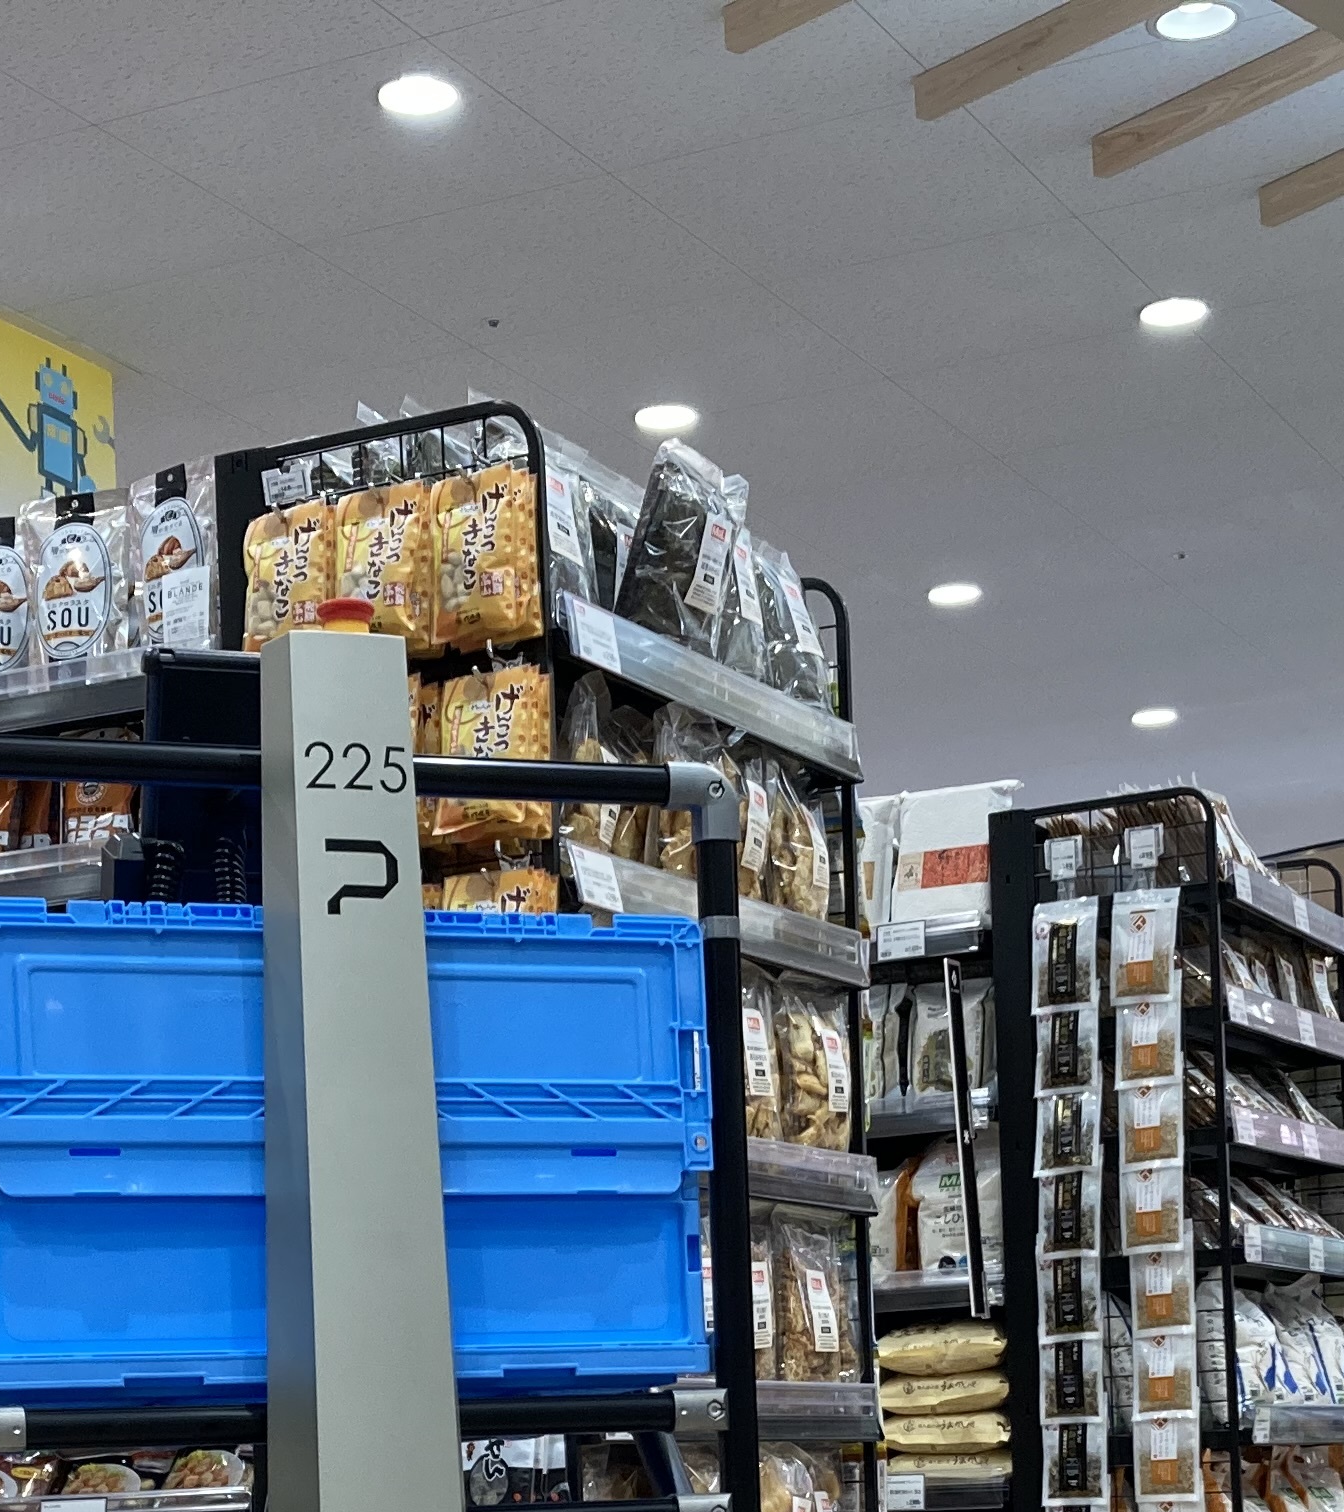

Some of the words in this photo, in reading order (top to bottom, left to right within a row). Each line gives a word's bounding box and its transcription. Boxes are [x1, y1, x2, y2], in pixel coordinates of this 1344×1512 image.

[386, 500, 416, 563] げんこつ
[480, 483, 508, 551] げんこつ
[294, 518, 320, 582] げんこつ
[367, 532, 389, 599] きなこ
[462, 518, 483, 590] きなこ
[167, 583, 203, 599] BLANDE
[274, 551, 294, 619] きなこ
[47, 607, 89, 631] SOU
[474, 716, 495, 758] きな
[494, 684, 524, 751] げんこつ
[304, 741, 407, 793] 225
